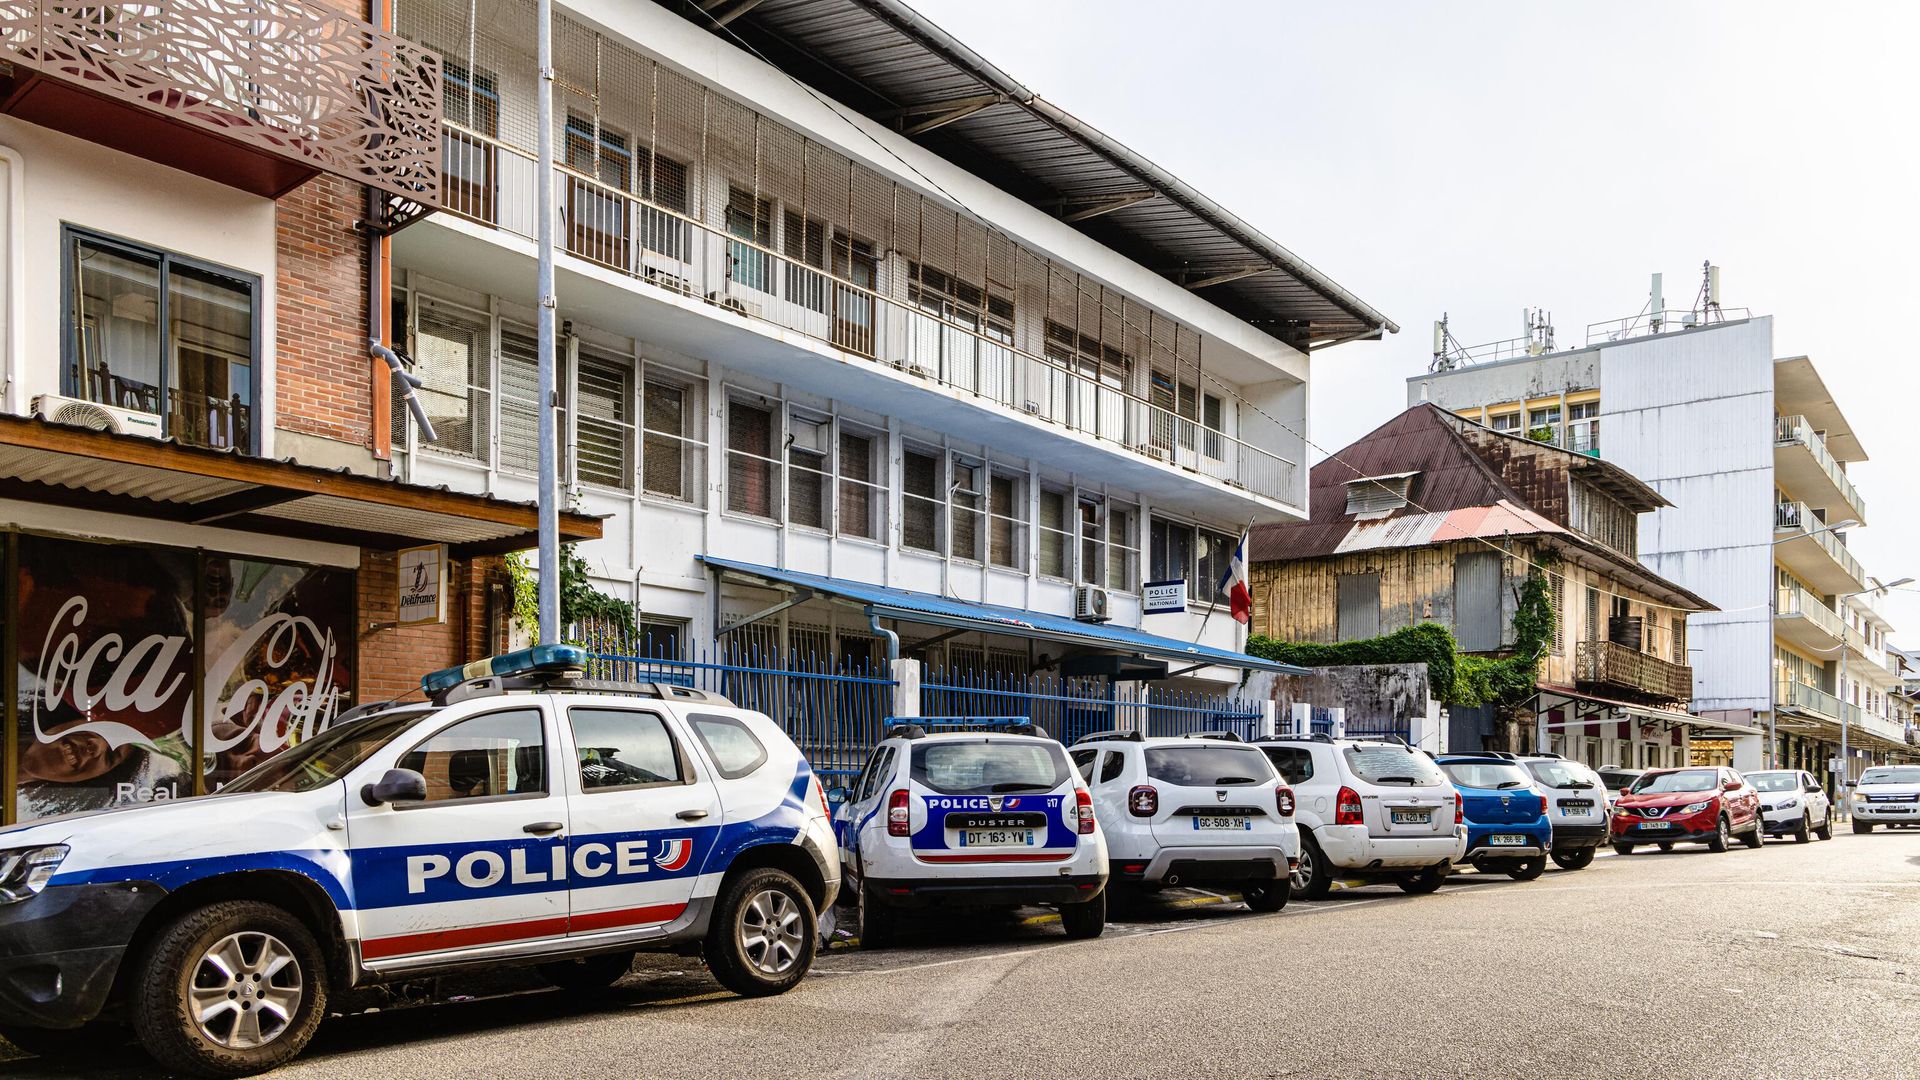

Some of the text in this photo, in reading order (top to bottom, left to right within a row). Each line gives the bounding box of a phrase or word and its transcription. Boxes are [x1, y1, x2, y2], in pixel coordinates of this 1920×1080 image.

[127, 416, 157, 427] Panasonic
[575, 680, 651, 692] DUSTER
[116, 782, 177, 802] Real
[929, 798, 988, 809] POLICE
[1199, 818, 1244, 828] GC-508-XH
[968, 831, 1024, 844] DT-163-YW
[407, 841, 649, 894] POLICE
